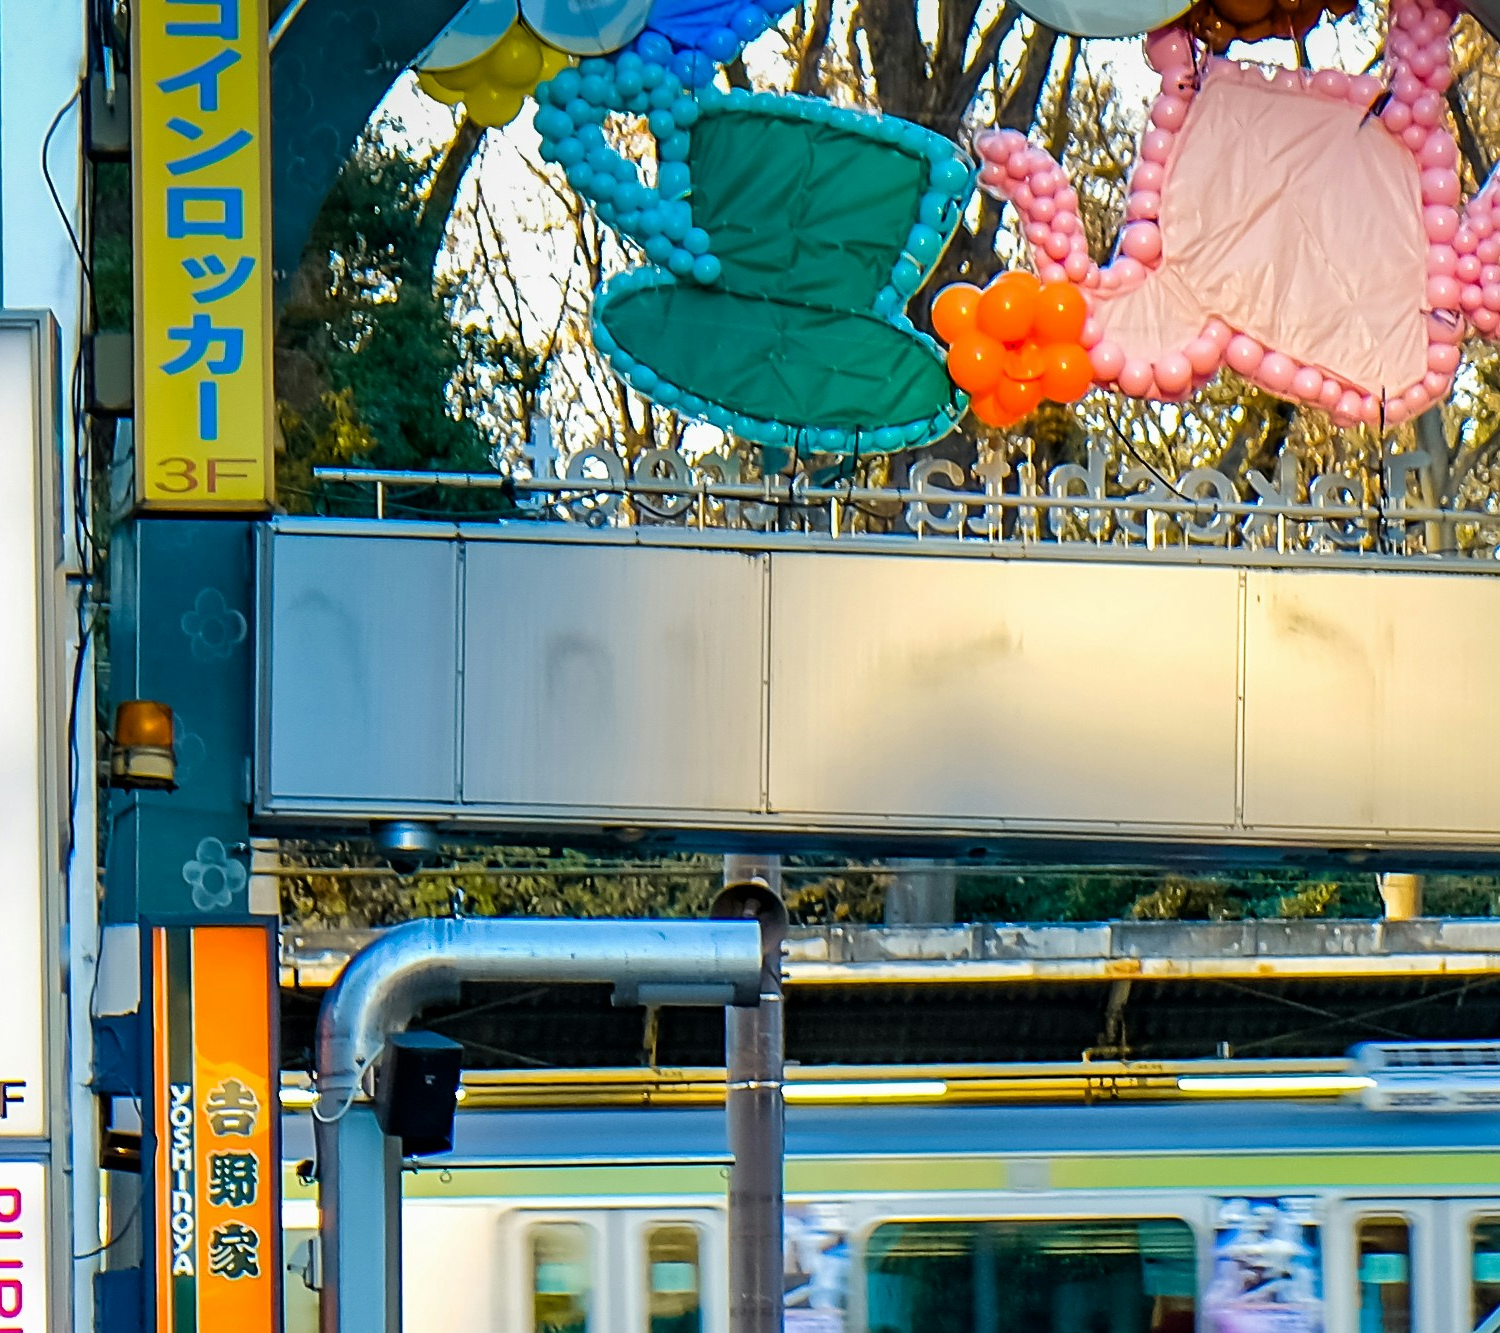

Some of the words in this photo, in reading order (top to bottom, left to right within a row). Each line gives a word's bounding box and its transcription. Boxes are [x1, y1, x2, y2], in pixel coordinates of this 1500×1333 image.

[156, 0, 255, 442] コインロッカー
[155, 457, 257, 495] 3F
